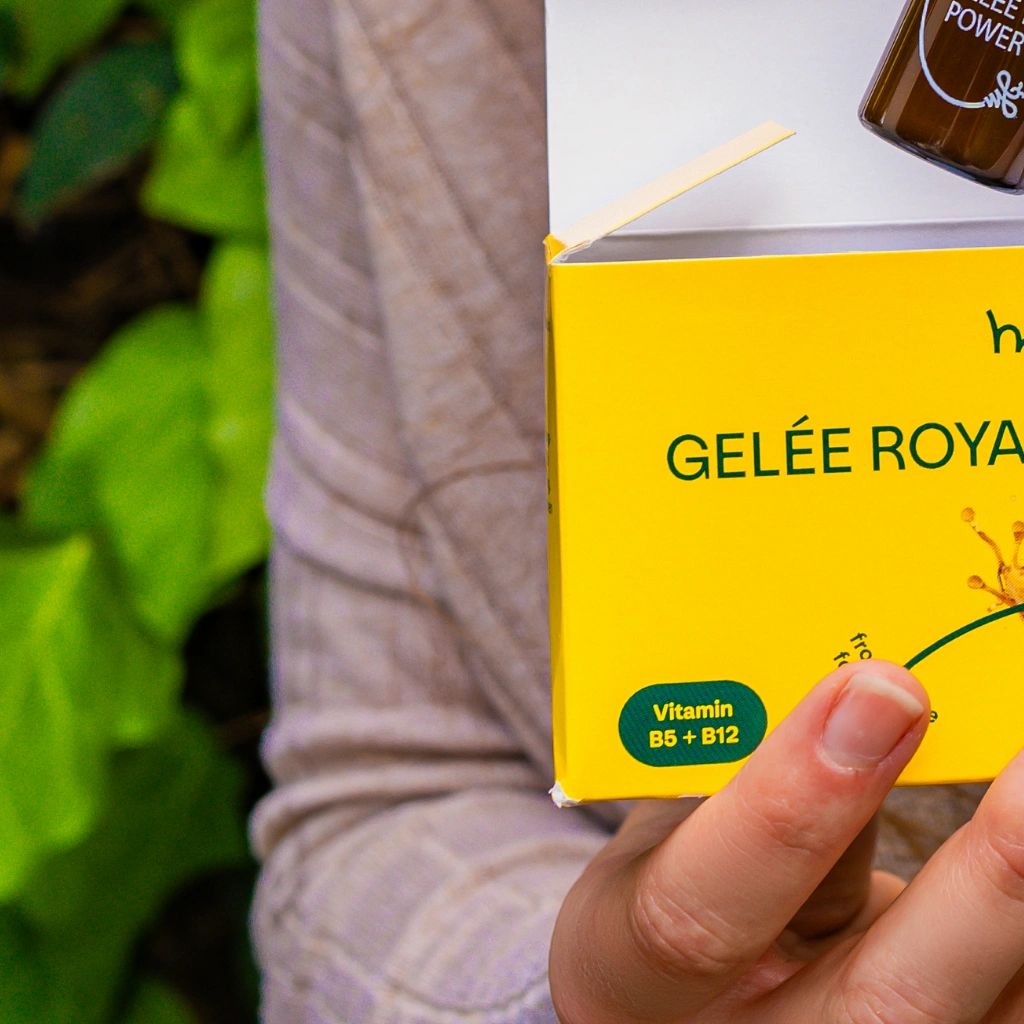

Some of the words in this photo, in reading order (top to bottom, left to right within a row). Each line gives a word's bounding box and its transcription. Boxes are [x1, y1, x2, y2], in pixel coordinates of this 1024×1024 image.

[666, 414, 852, 481] GELÉE
[652, 699, 733, 722] Vitamin
[649, 729, 678, 749] B5
[682, 730, 697, 745] +
[701, 725, 739, 746] B12
